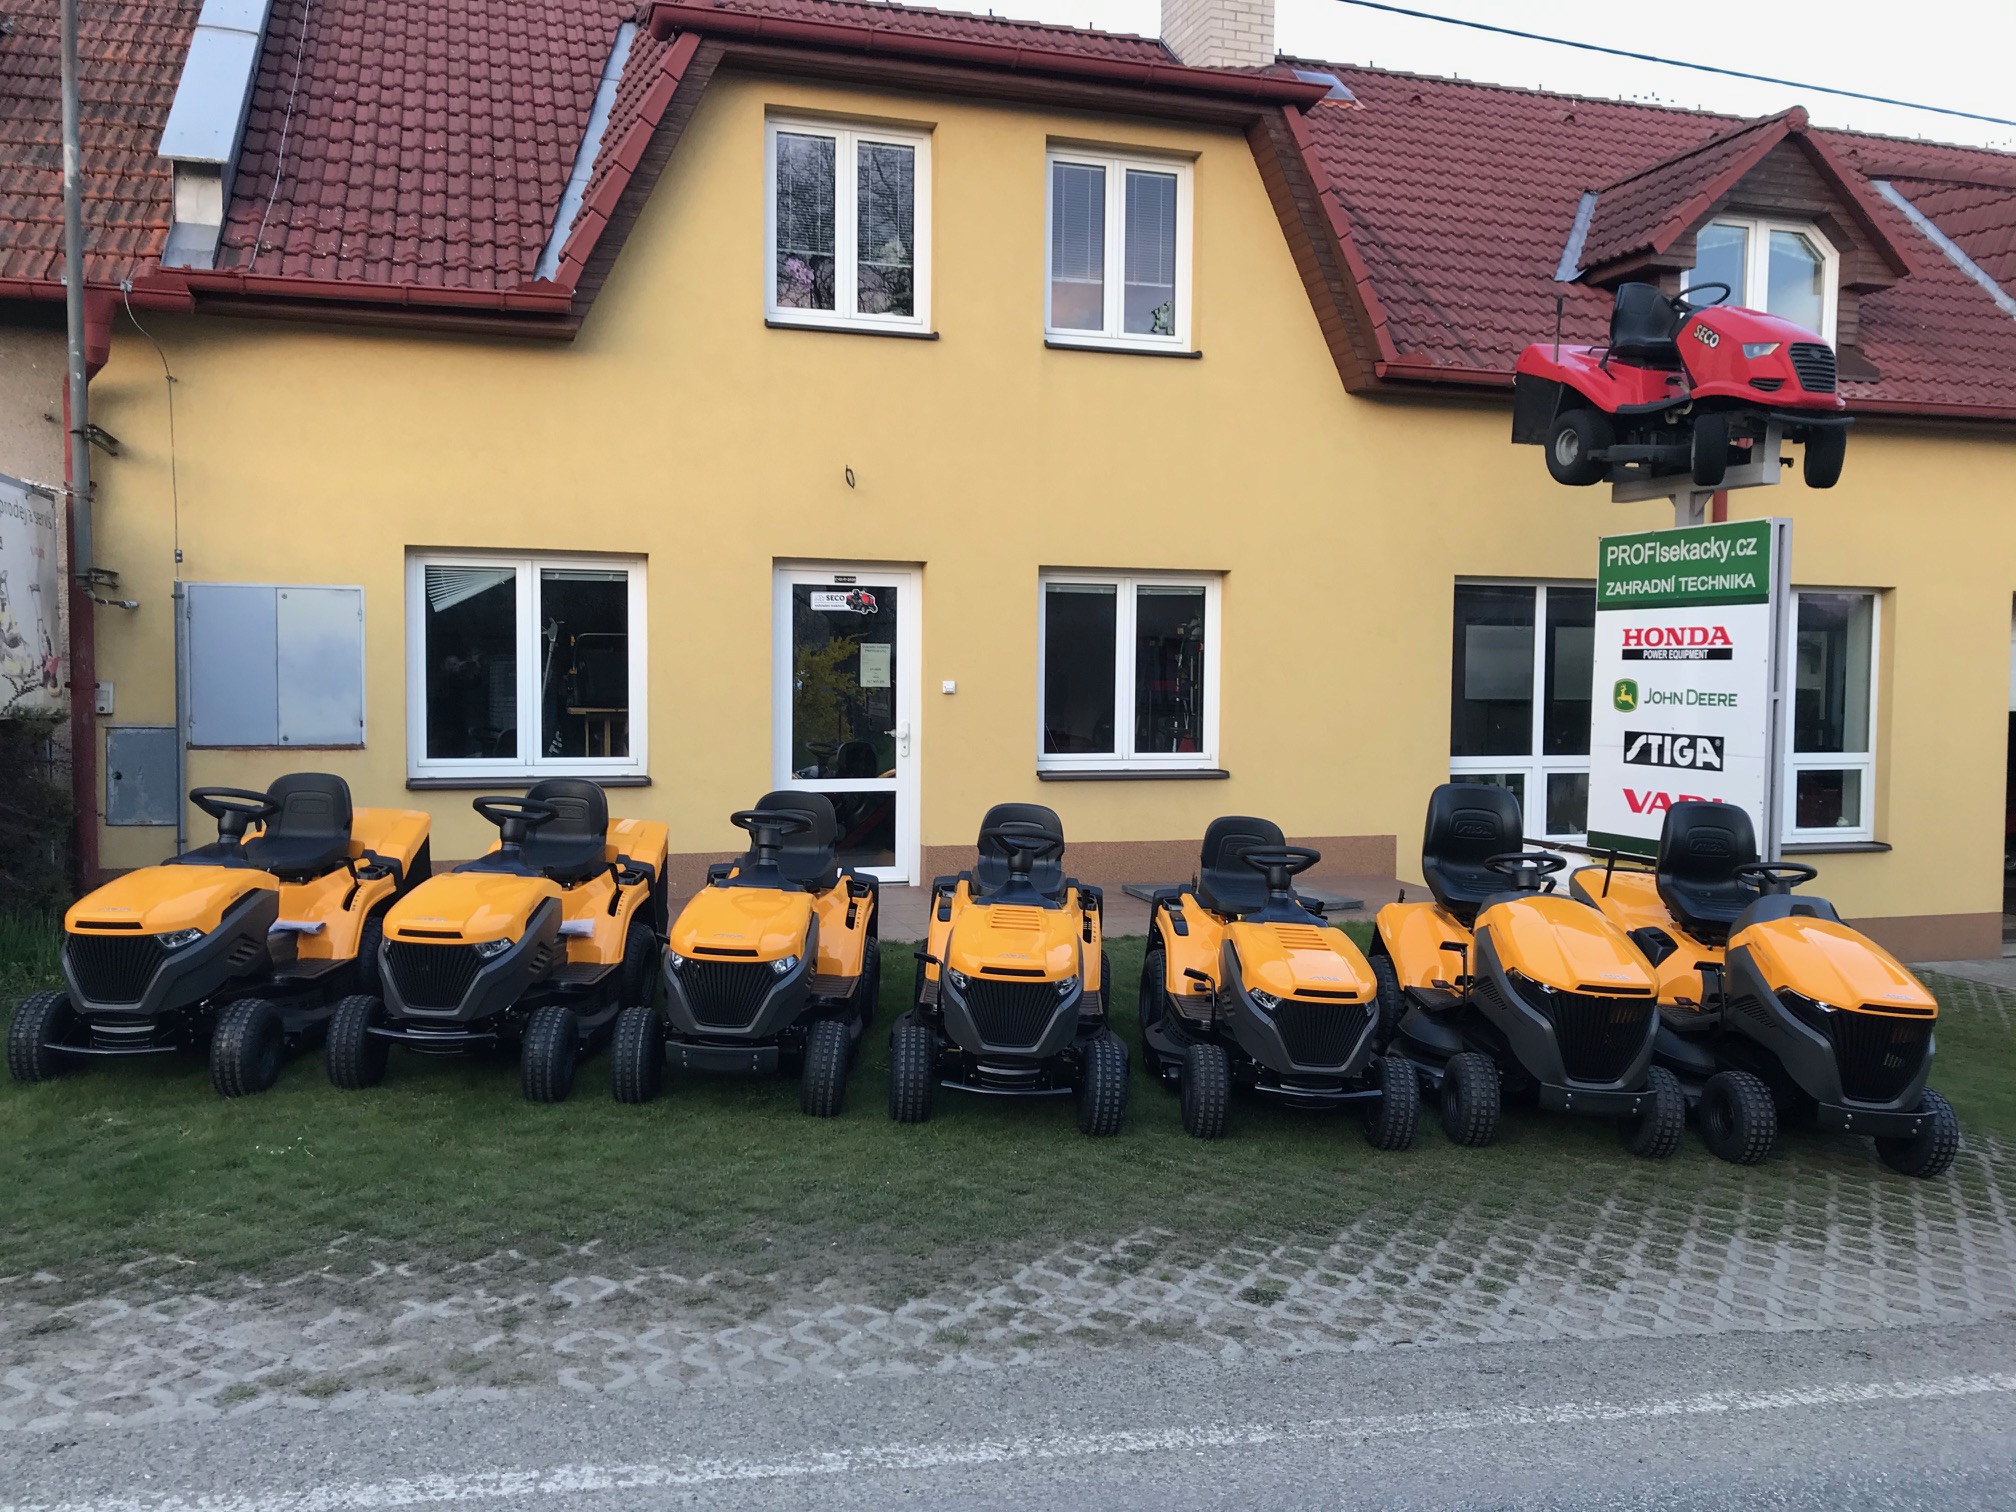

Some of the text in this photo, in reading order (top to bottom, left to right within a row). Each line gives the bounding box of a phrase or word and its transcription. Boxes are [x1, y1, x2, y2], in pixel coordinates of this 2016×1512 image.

[1693, 324, 1720, 348] SECO
[1606, 536, 1758, 567] PROFIsekacky.cz
[1606, 573, 1756, 596] ZAHRADNÍ TECHNIKA
[826, 594, 846, 602] SECO
[1622, 626, 1733, 647] HONDA
[1642, 649, 1709, 660] POWER EQUIPMENT
[1626, 734, 1721, 769] STIGA
[1622, 787, 1723, 815] VA
